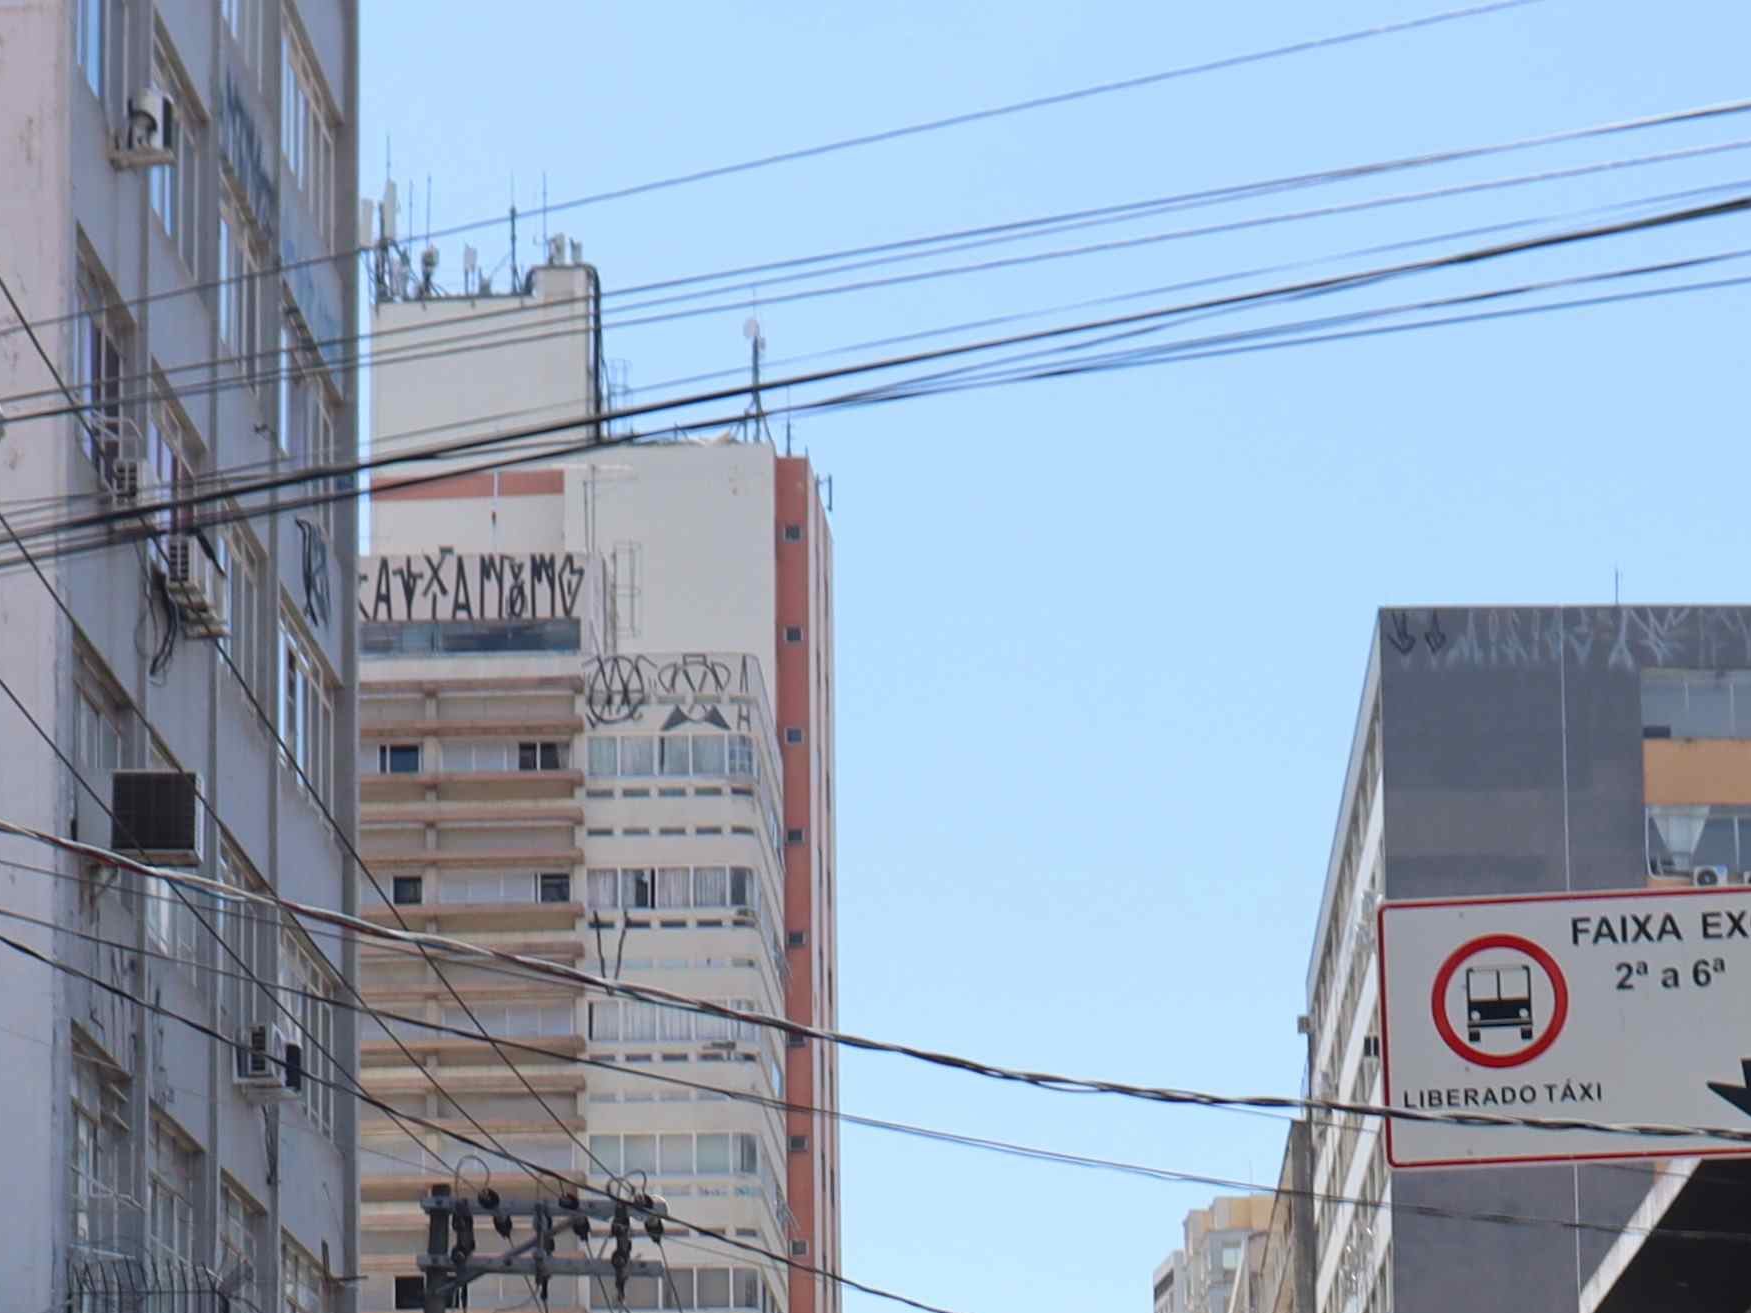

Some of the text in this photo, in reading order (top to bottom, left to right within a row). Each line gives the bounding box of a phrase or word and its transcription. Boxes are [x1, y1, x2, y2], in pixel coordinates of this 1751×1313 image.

[1571, 913, 1682, 946] FAIXA
[1615, 961, 1649, 990] 2ª
[1661, 967, 1679, 989] a
[1692, 957, 1725, 987] 6ª
[1403, 1078, 1602, 1109] LIBERADO TÁXI
